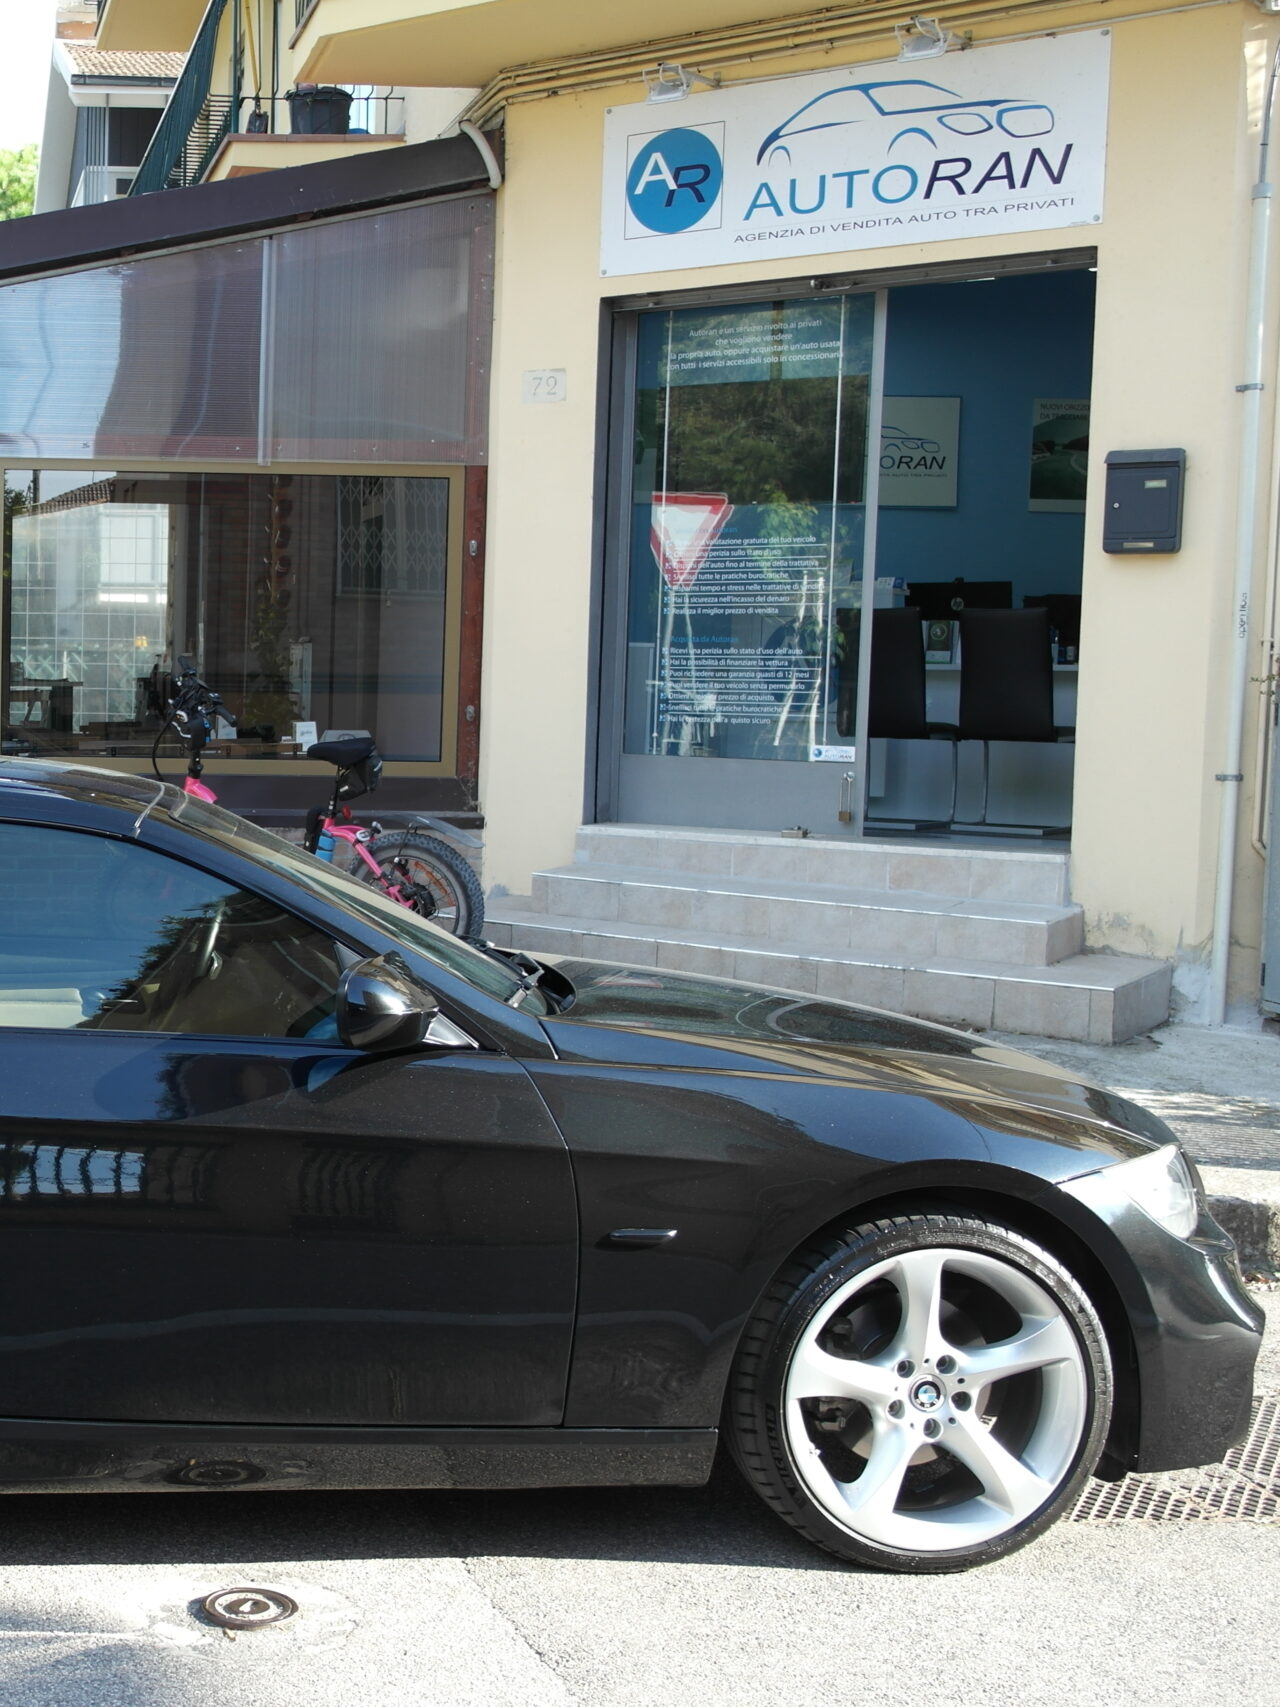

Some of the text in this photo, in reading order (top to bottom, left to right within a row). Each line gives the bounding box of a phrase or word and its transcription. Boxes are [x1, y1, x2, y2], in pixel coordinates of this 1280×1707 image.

[742, 142, 1073, 221] AUTORAN
[734, 197, 1074, 243] AGENZIA DI VENDITA AUTO TRA PRIVATI
[798, 319, 822, 329] privati
[715, 336, 728, 345] che
[763, 355, 779, 363] solo
[532, 375, 558, 396] 72
[793, 535, 816, 543] veicolo
[721, 572, 747, 580] pratiche
[700, 584, 721, 592] tempo
